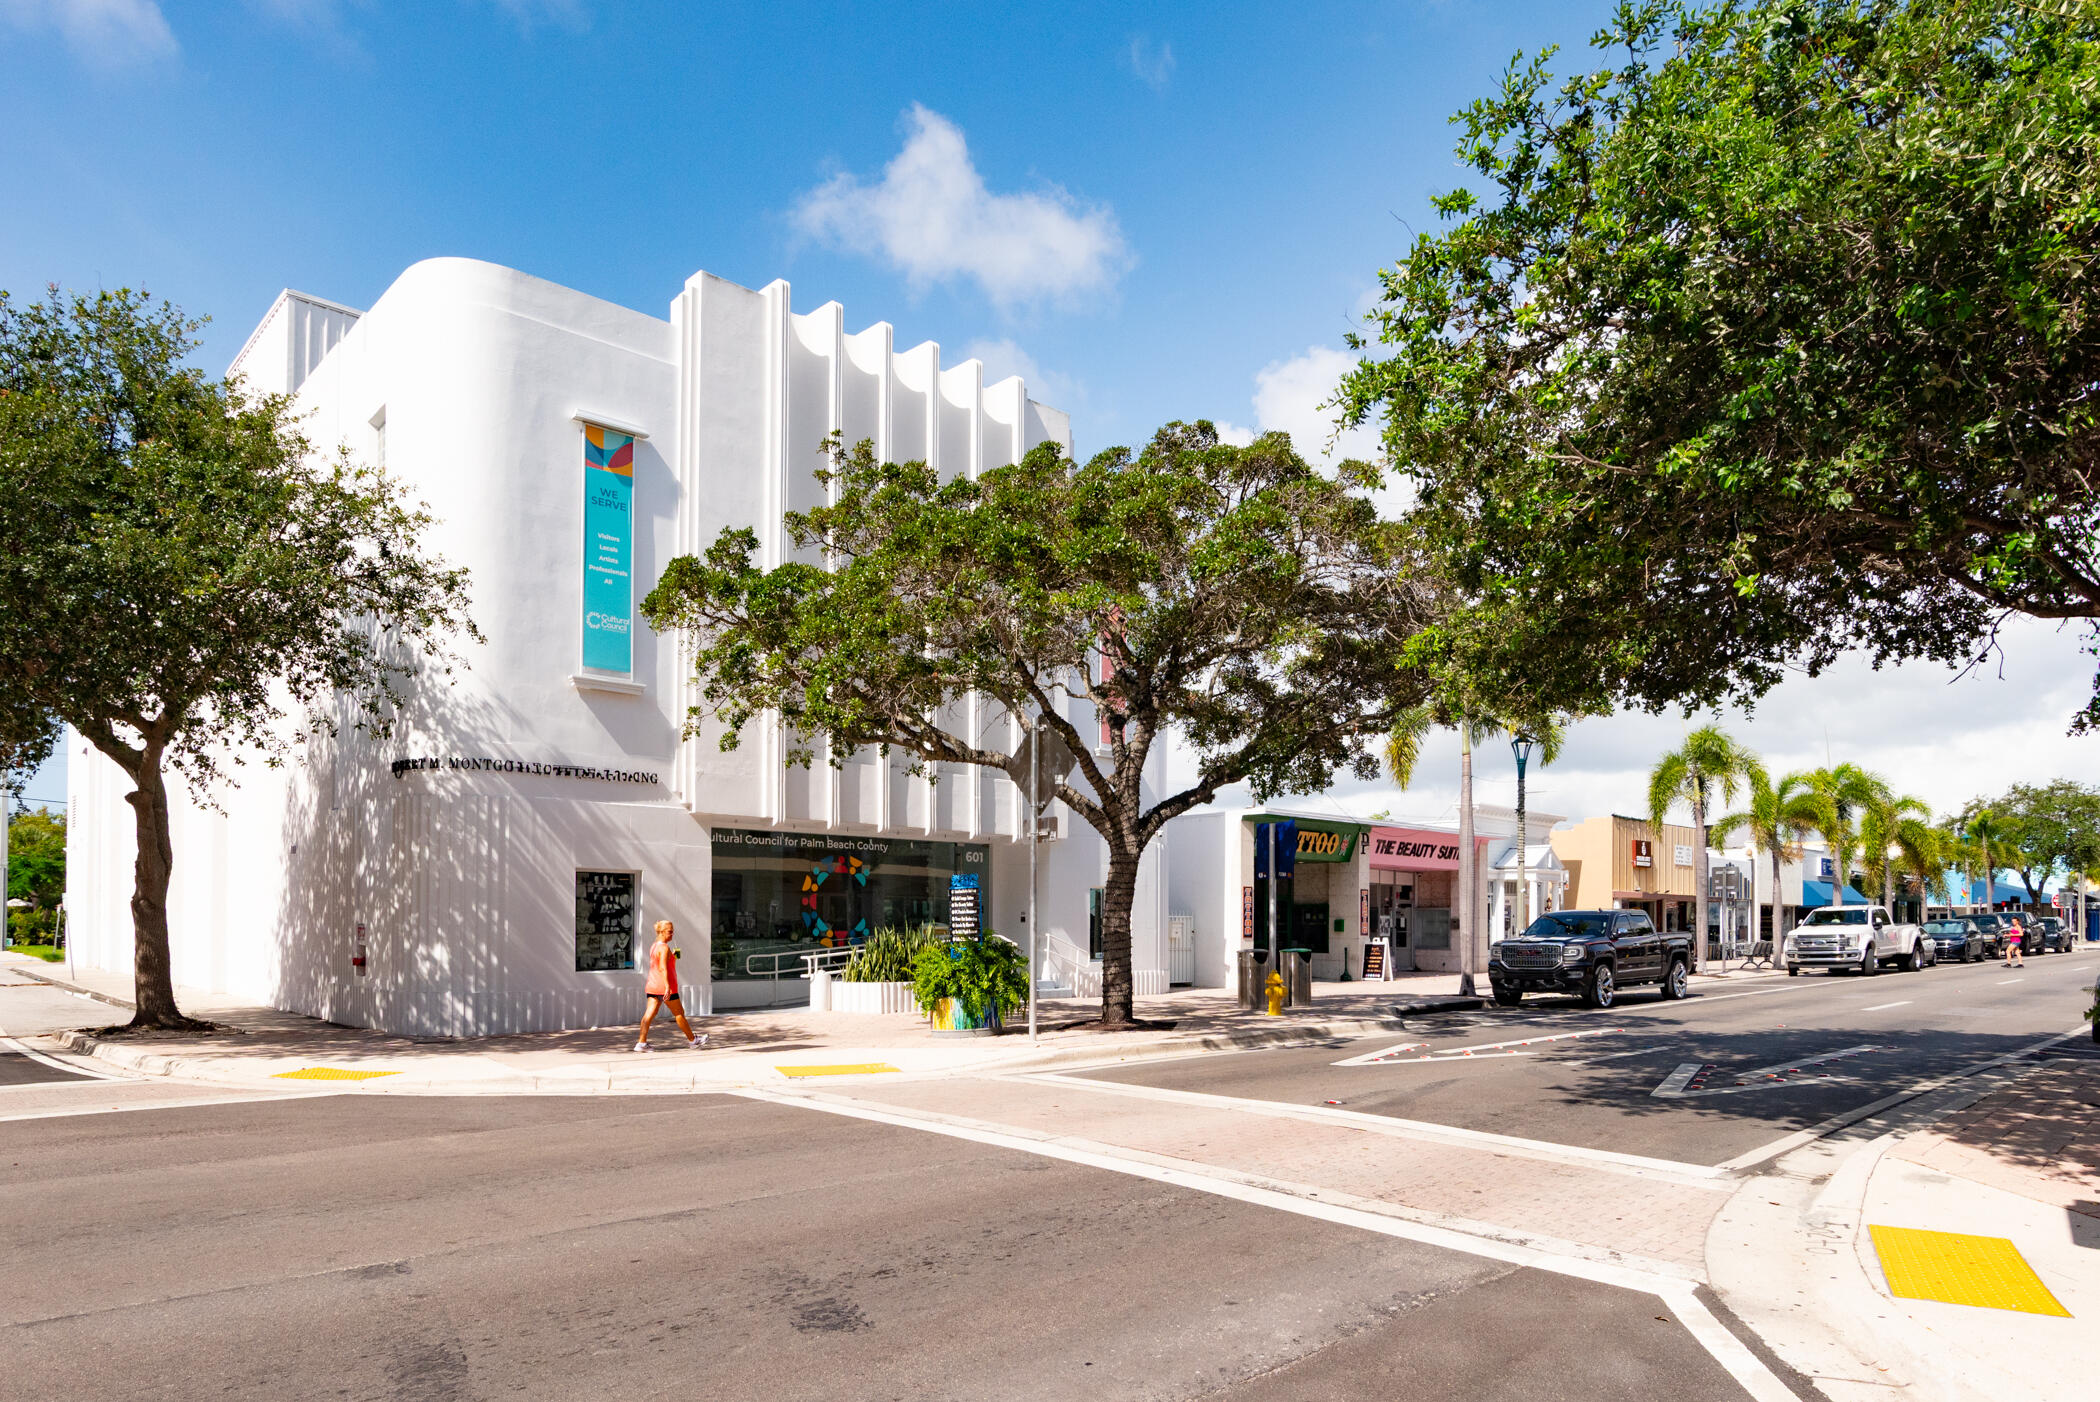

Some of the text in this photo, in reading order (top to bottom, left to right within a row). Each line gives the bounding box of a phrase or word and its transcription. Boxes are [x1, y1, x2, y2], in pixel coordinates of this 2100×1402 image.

[600, 487, 619, 500] WE
[591, 496, 627, 512] SERVE
[597, 532, 620, 543] Visitors
[599, 544, 619, 553] Locals
[598, 555, 619, 565] Artists
[588, 564, 628, 577] Professionals
[600, 613, 631, 625] Cultural
[600, 621, 628, 632] Council
[711, 832, 889, 854] ultural Council for Palm Beach County
[1296, 830, 1340, 855] TTOO
[1375, 839, 1397, 855] THE
[1396, 841, 1437, 858] BEAUTY
[965, 851, 984, 863] 601
